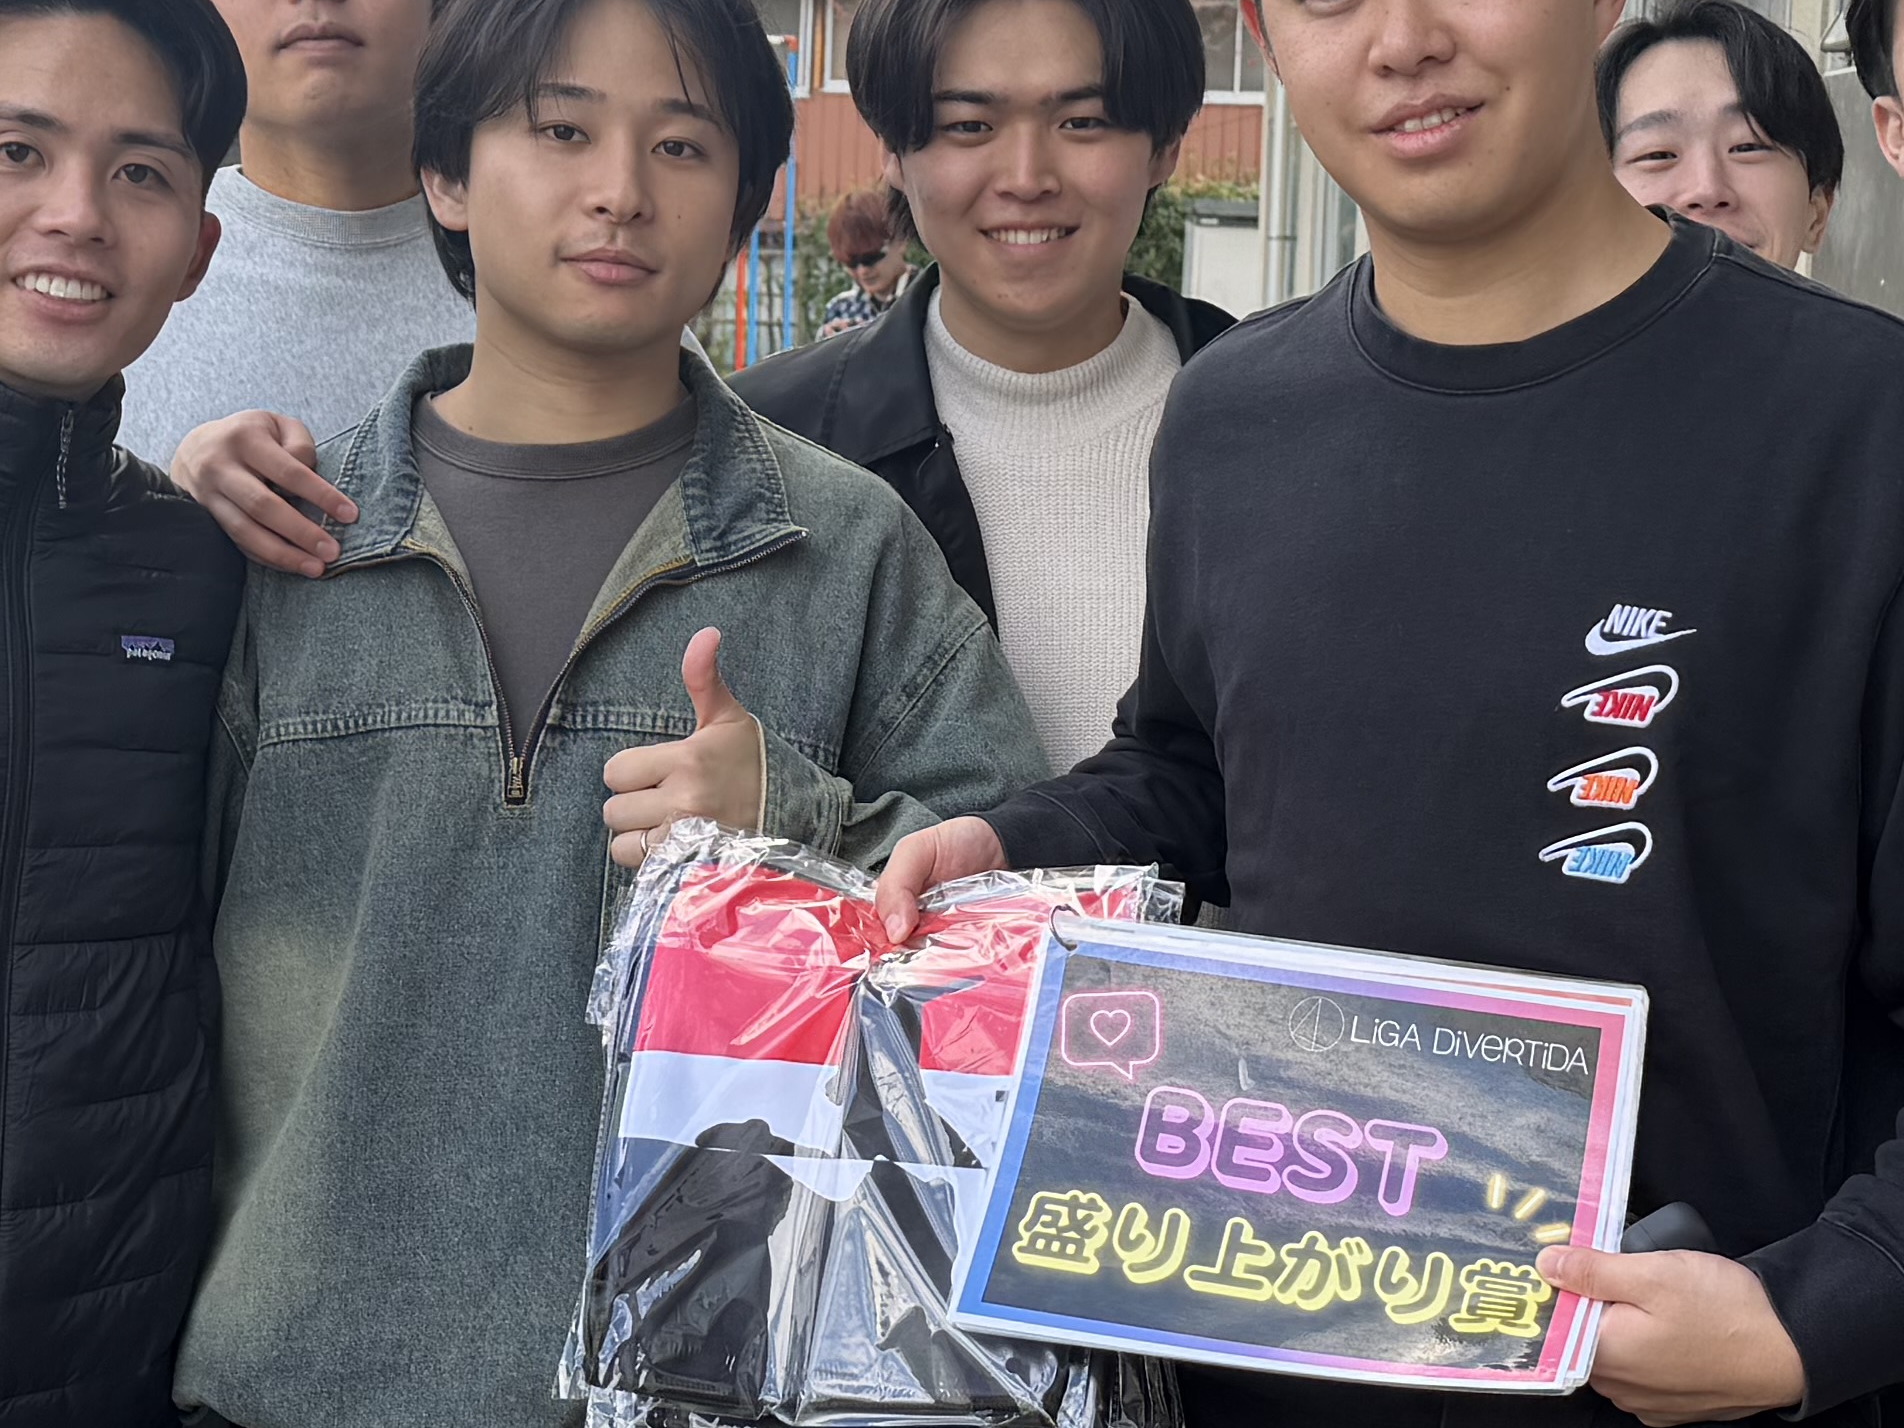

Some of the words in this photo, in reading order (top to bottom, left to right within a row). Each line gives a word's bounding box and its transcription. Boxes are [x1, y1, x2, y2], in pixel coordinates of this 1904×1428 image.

[1603, 603, 1673, 638] NIKE
[1590, 689, 1656, 722] NIKE
[1578, 774, 1640, 804] NIKE
[1568, 845, 1633, 878] NIKE
[1135, 1086, 1448, 1216] BEST
[1013, 1189, 1552, 1338] 盛り上がり賞
